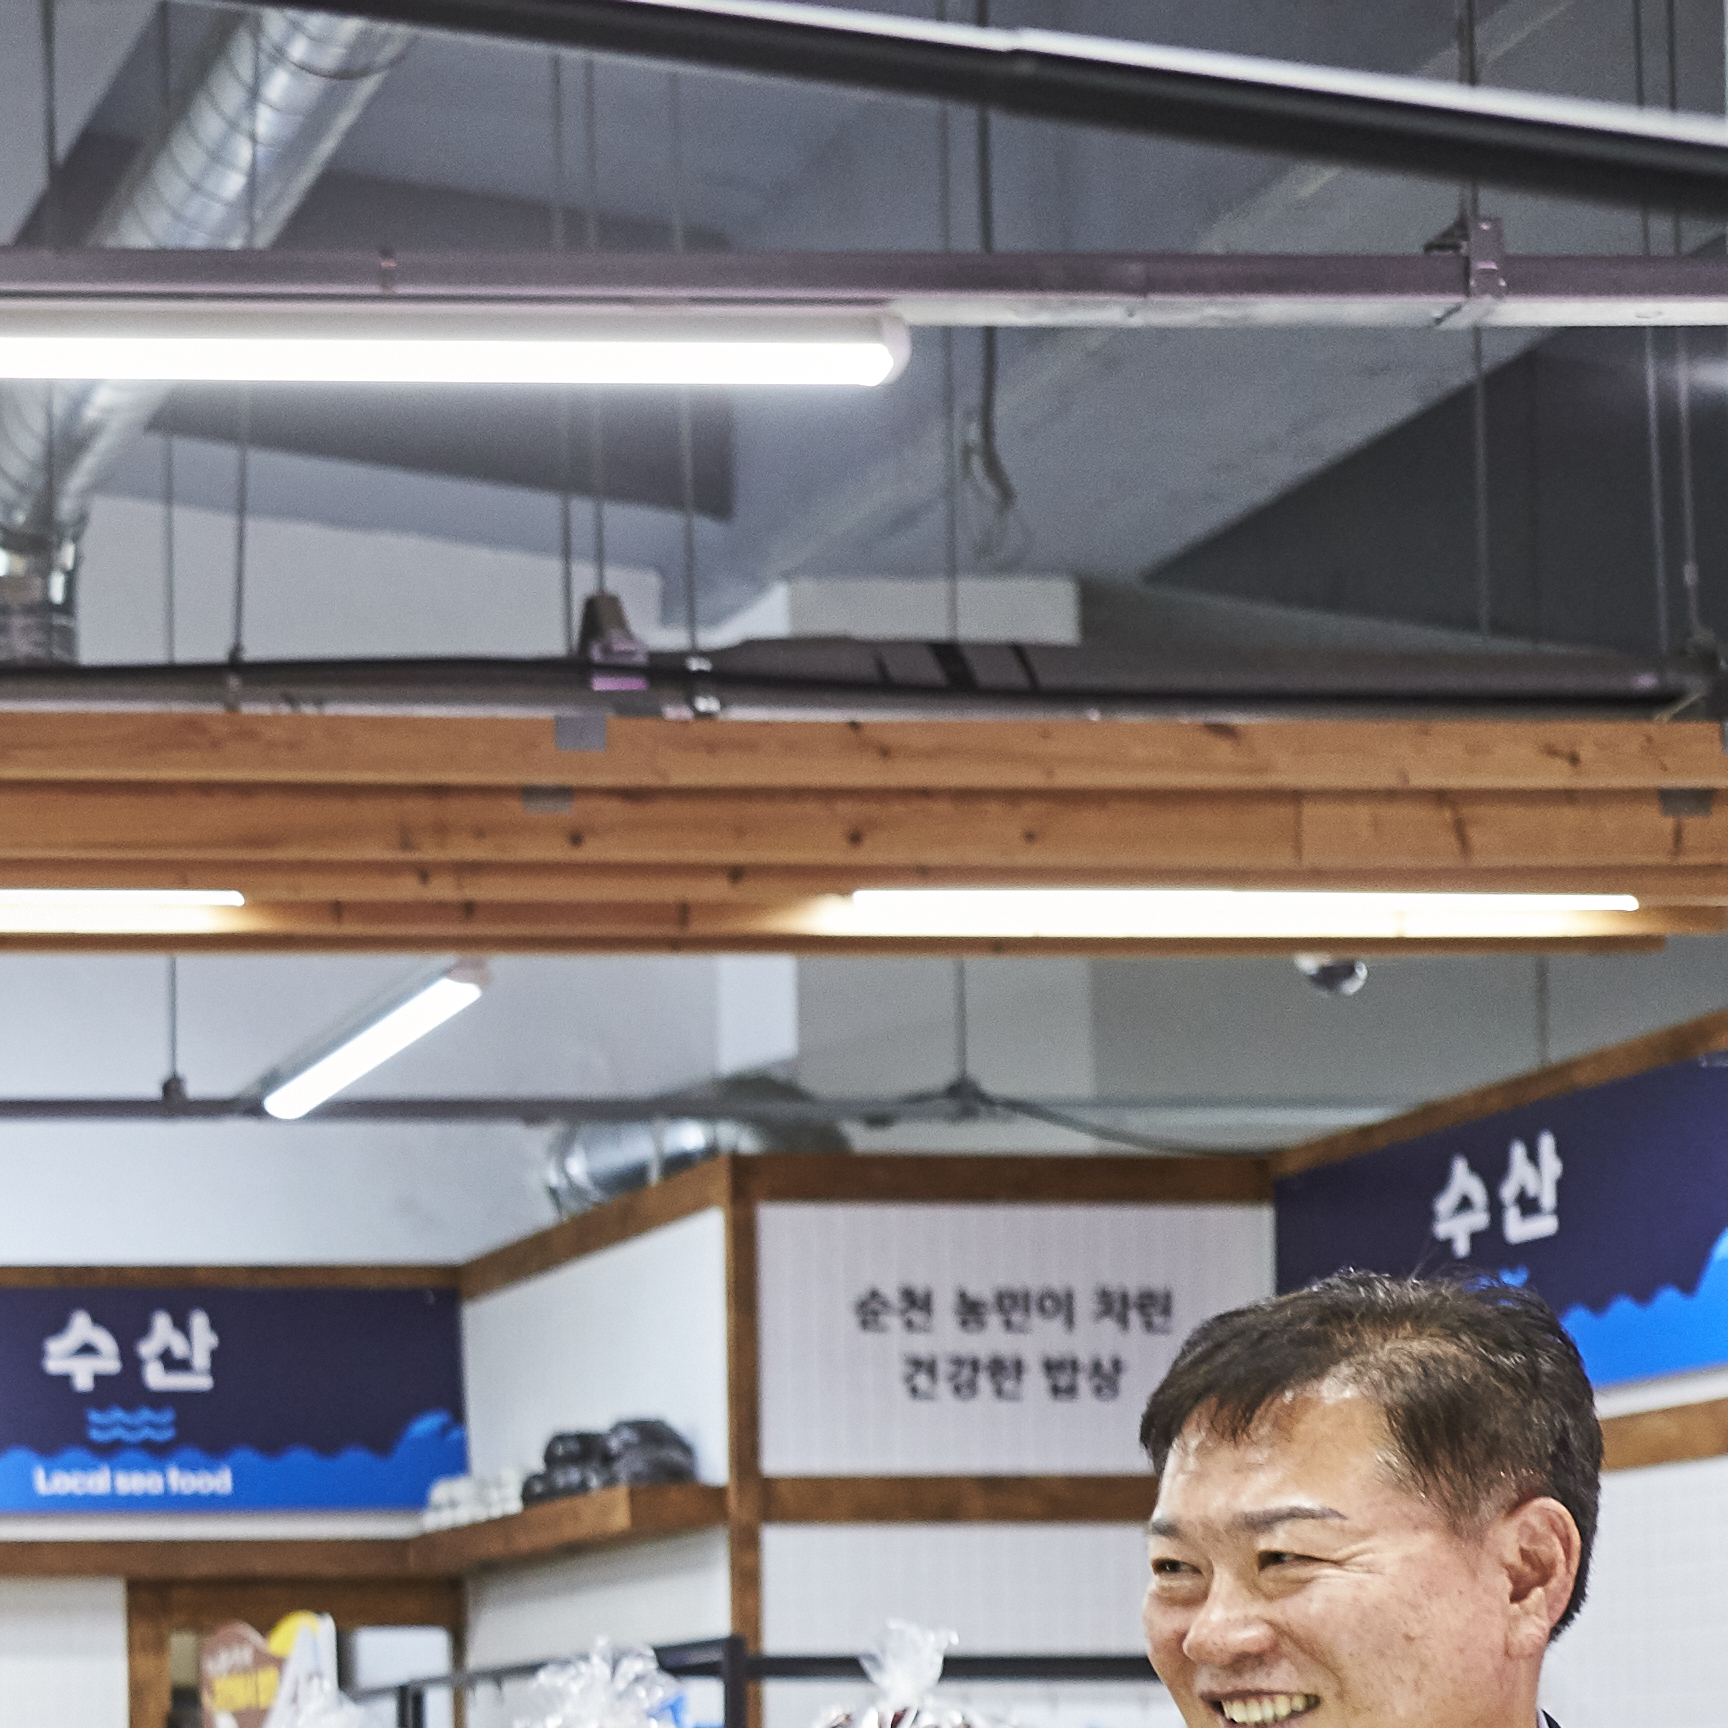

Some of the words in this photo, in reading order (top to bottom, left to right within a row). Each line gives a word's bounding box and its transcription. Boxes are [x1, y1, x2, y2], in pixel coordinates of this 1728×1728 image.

[1432, 1129, 1563, 1258] 수산
[853, 1285, 935, 1334] 순천
[953, 1285, 1076, 1334] 농민이
[1093, 1285, 1173, 1335] 차린
[42, 1308, 220, 1393] 수산
[902, 1353, 1024, 1400] 건강한
[1042, 1353, 1124, 1400] 밥상
[33, 1464, 111, 1496] Local
[165, 1464, 233, 1496] food
